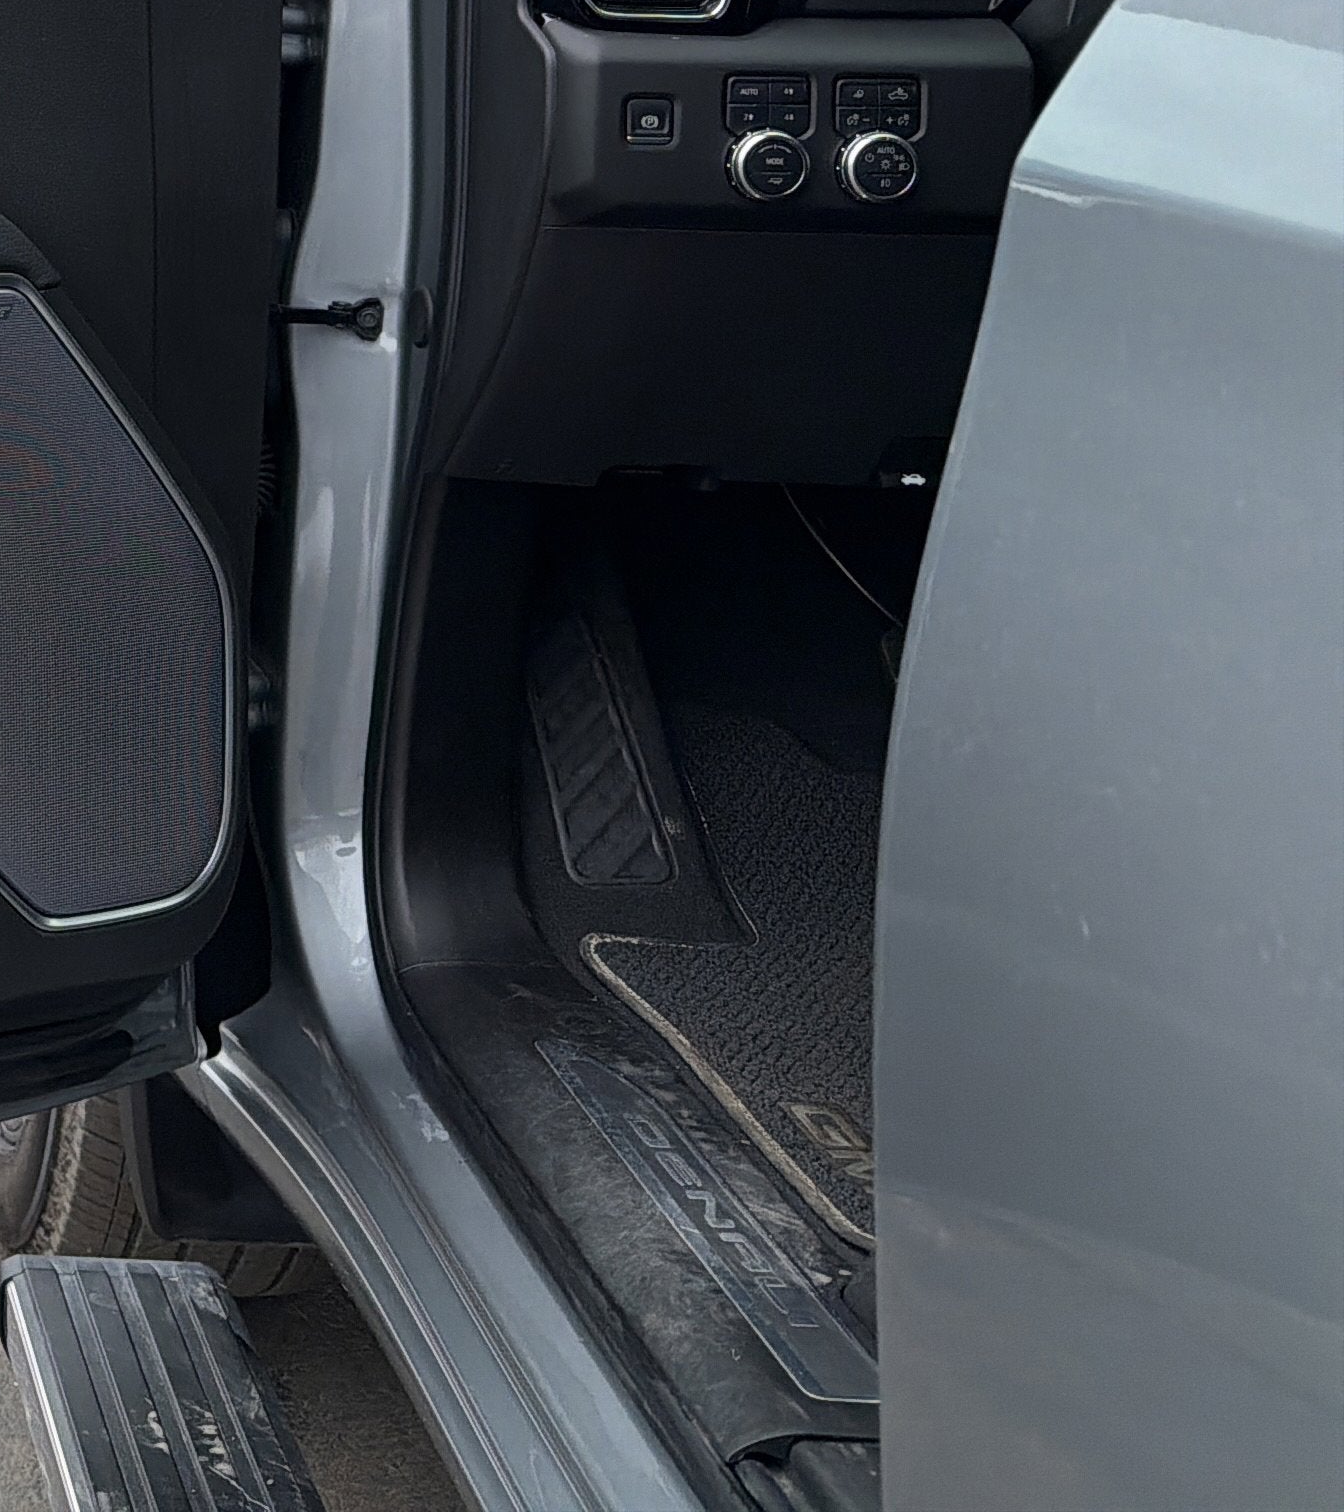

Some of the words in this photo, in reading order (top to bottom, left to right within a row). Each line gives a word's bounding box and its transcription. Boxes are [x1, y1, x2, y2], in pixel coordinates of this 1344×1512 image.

[740, 88, 759, 96] AUTO
[877, 146, 896, 155] AUTO
[765, 157, 784, 165] MODE
[623, 1113, 819, 1327] DENALI
